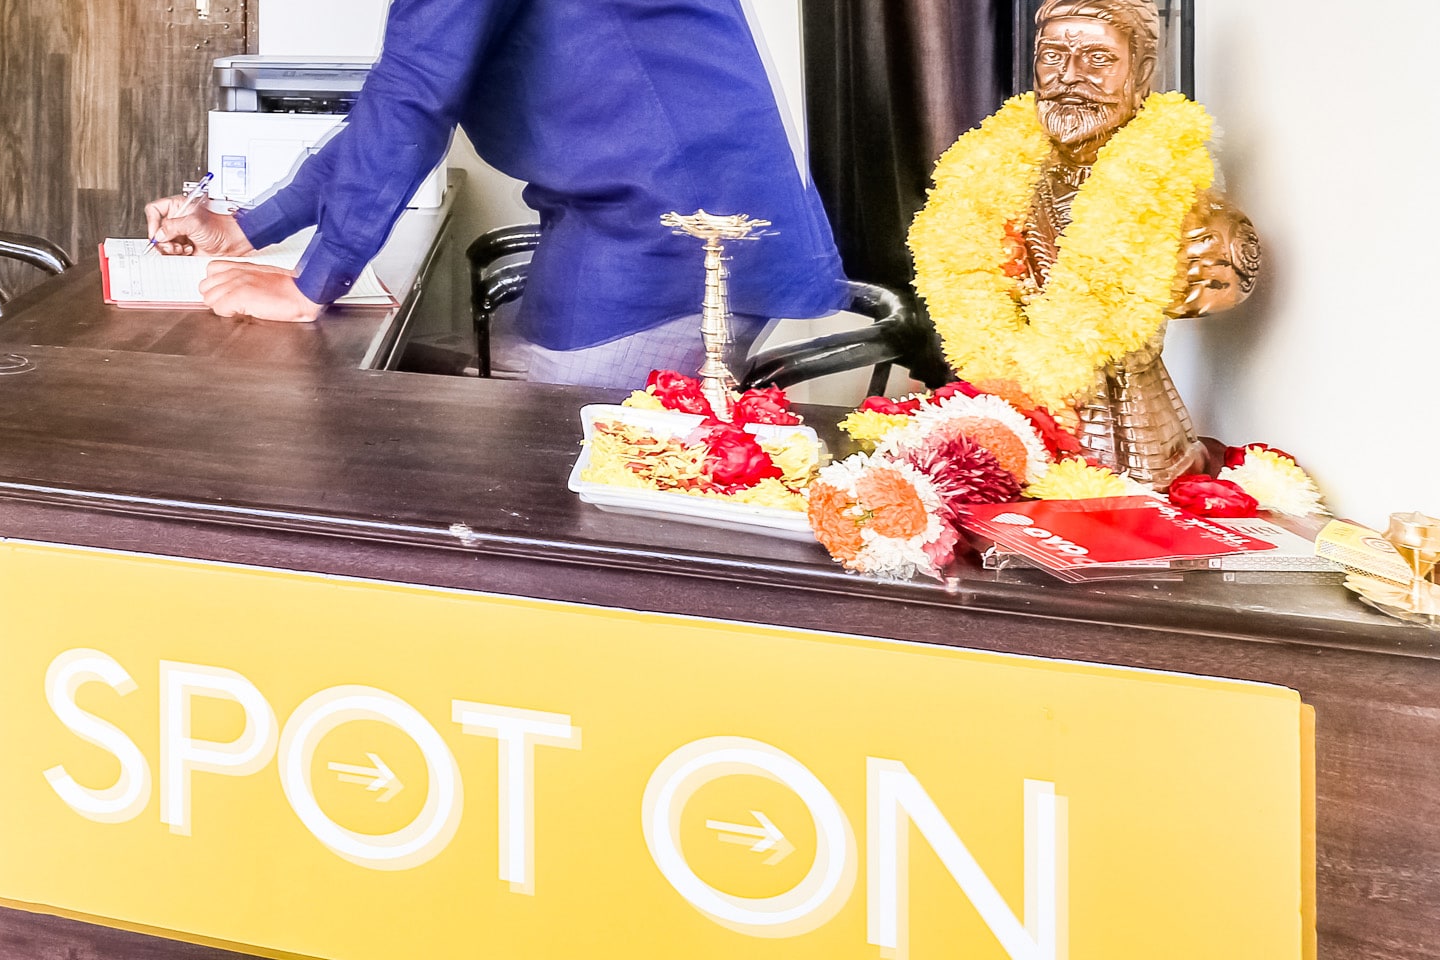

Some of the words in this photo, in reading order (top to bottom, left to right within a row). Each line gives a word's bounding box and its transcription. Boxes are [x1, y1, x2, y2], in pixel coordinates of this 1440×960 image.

[1023, 527, 1089, 555] OYO
[1184, 518, 1251, 545] Thank
[42, 647, 582, 896] SPOT
[641, 735, 1069, 960] ON
